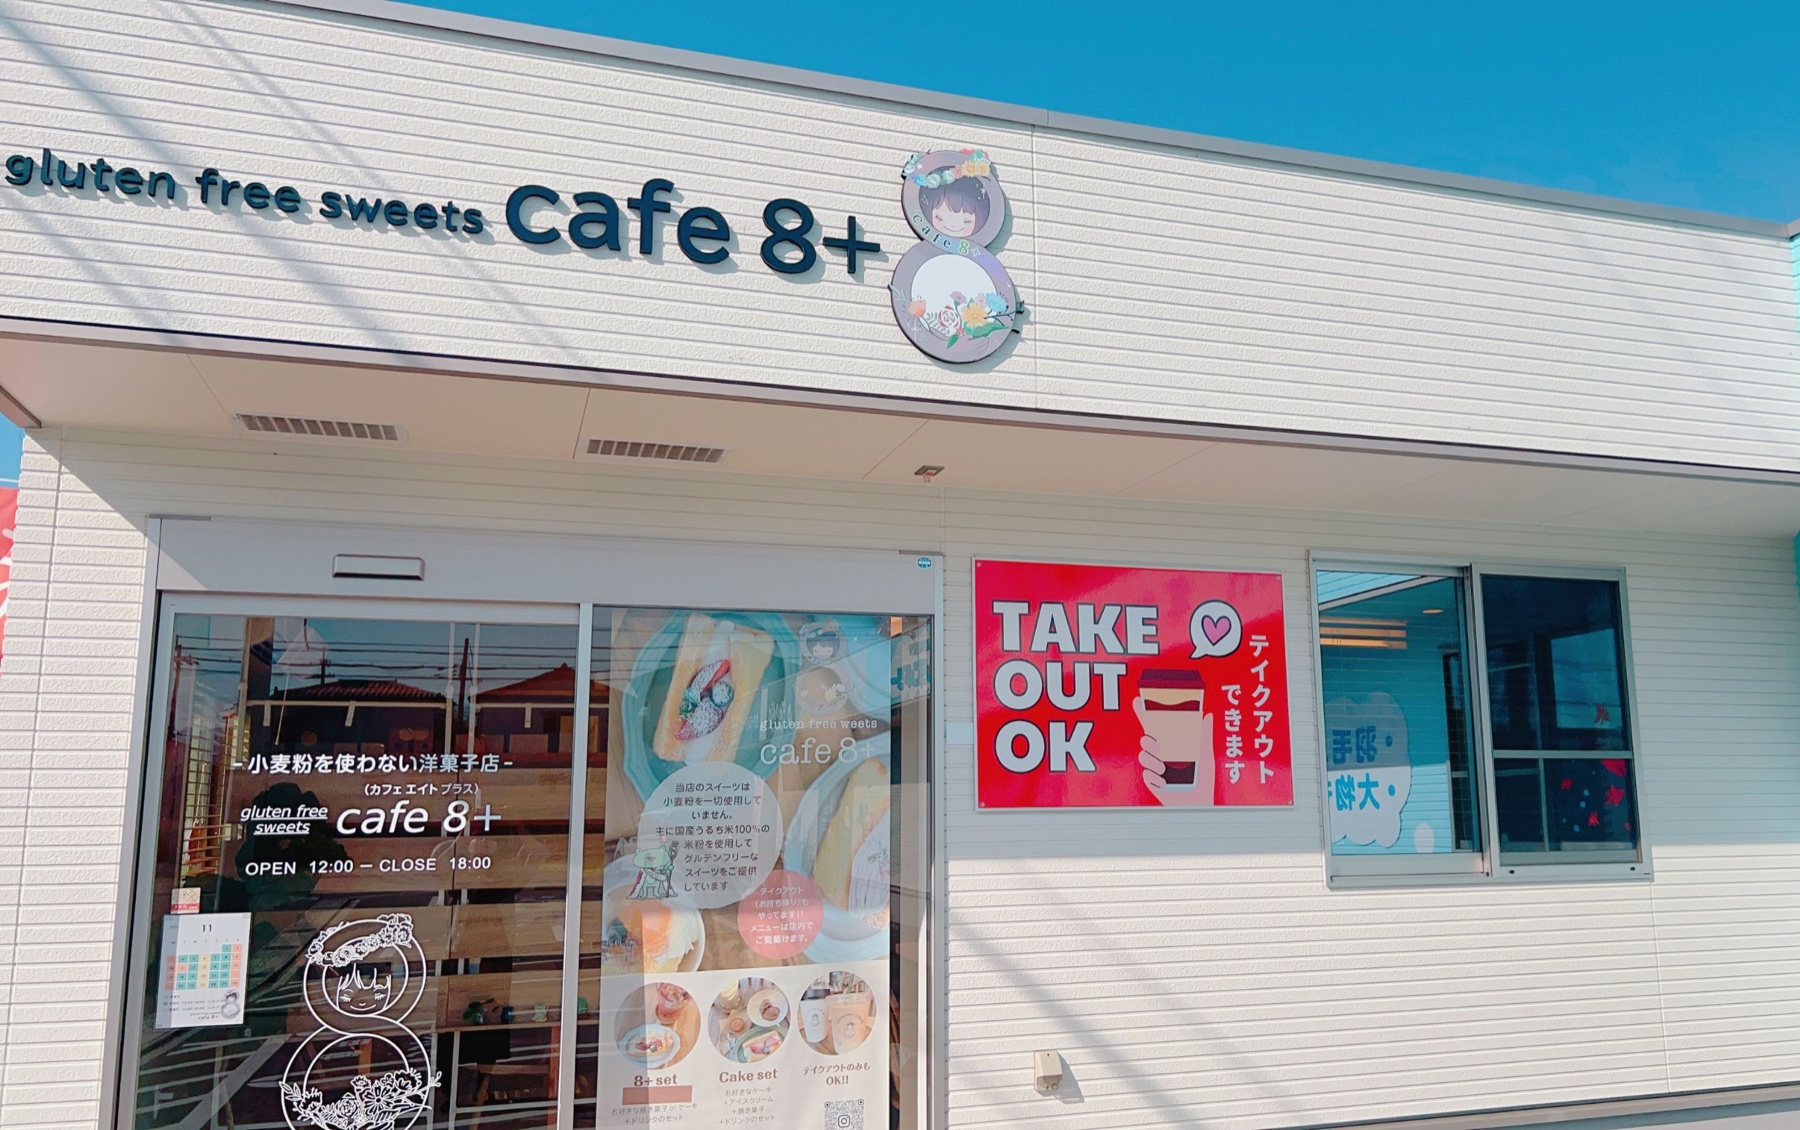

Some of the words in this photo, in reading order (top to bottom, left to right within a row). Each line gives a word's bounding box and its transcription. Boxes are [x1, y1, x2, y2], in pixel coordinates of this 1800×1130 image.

[5, 148, 176, 200] gluten
[196, 168, 300, 213] free
[320, 190, 484, 234] sweets
[505, 178, 730, 265] cafe
[760, 198, 881, 274] 8+
[913, 214, 952, 249] cafe
[991, 600, 1160, 655] TAKE
[993, 658, 1127, 712] OUT
[1249, 633, 1275, 785] テイクアウト
[760, 718, 805, 732] gluten
[808, 718, 837, 729] free
[1221, 683, 1246, 785] できます
[760, 737, 832, 765] cafe
[994, 718, 1097, 774] OK
[675, 782, 750, 793] 当店のスイーツは
[663, 796, 761, 807] 小麦粉を一切使用して
[240, 804, 295, 822] gluten
[296, 803, 329, 818] free
[336, 798, 429, 836] cafe
[443, 799, 501, 833] 8+
[691, 810, 733, 820] いません。
[255, 820, 311, 834] sweets
[655, 824, 770, 836] 主に国産うるち米100%の
[684, 838, 753, 849] 米粉を使用して
[685, 852, 759, 864] グルテンフリーな
[245, 861, 296, 876] OPEN
[309, 860, 354, 874] 12:00
[379, 858, 437, 872] CLOSE
[449, 856, 492, 870] 18:00
[685, 866, 757, 877] スイーツをご提供
[684, 881, 728, 892] しています
[760, 887, 804, 896] テイクアウト
[750, 921, 814, 933] メニューは店内で
[719, 1070, 754, 1083] Cake
[757, 1068, 778, 1080] set
[802, 1062, 871, 1076] テイクアウトのみも
[633, 1074, 653, 1087] 8+
[656, 1074, 678, 1085] set
